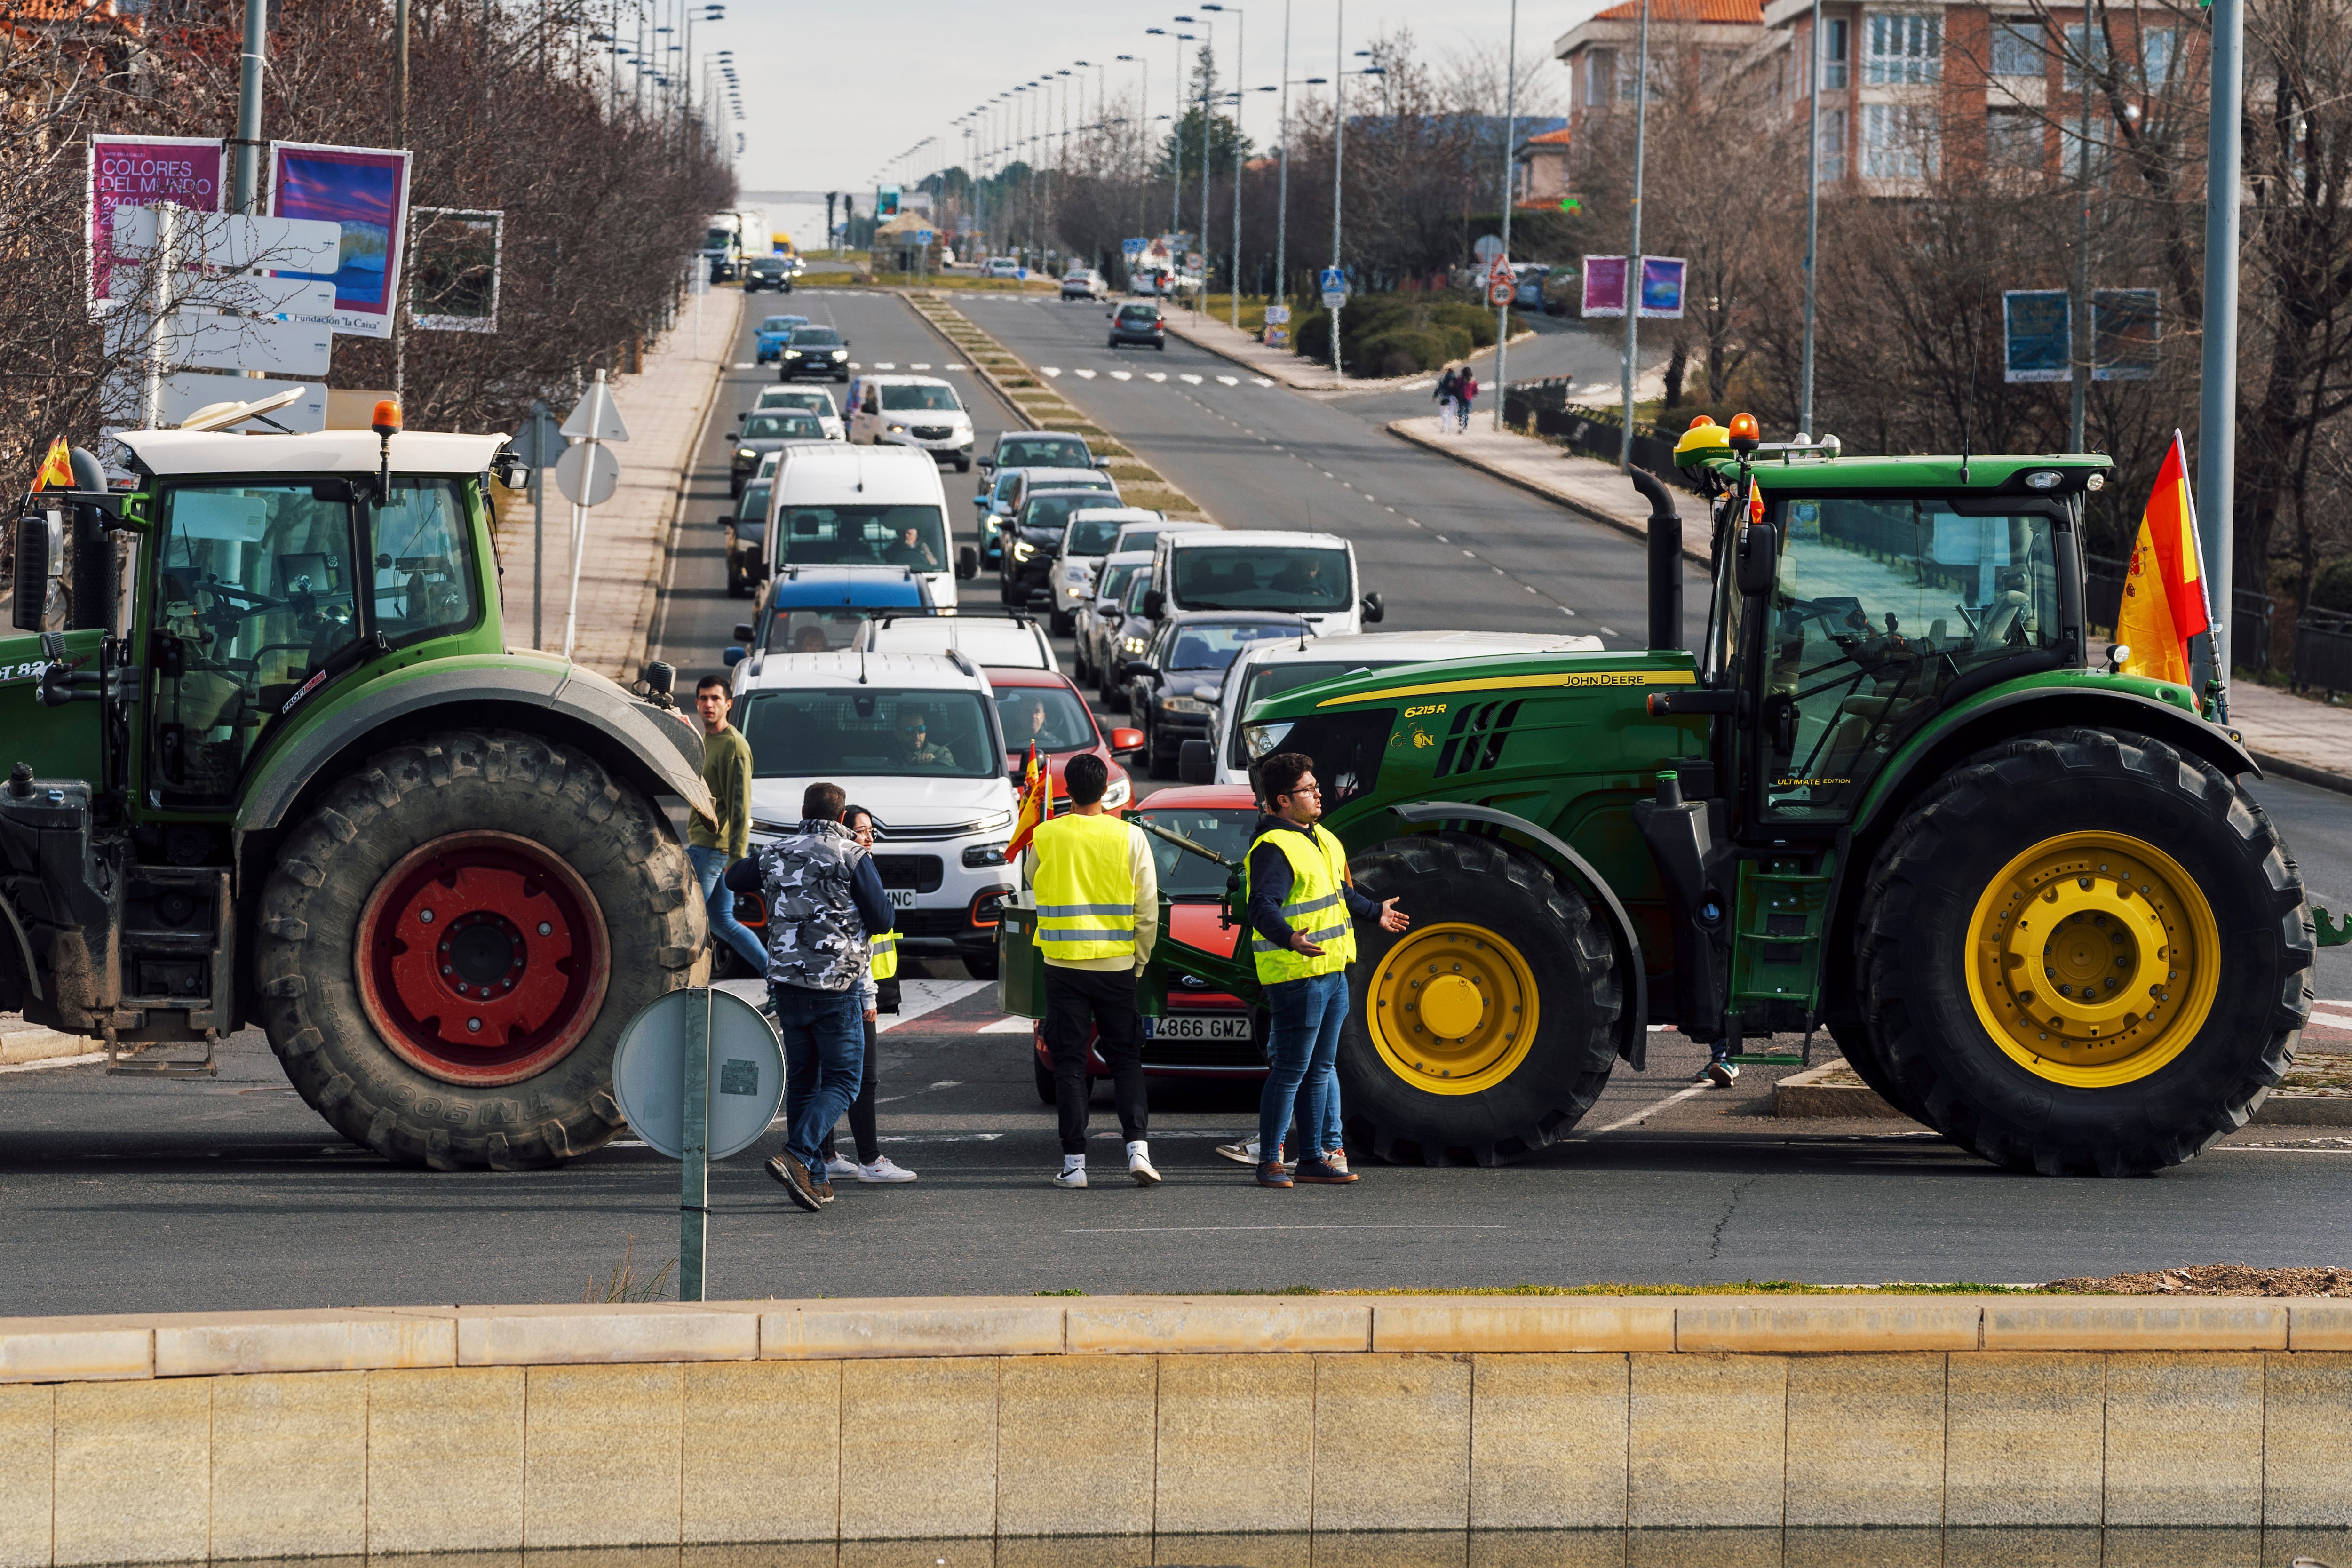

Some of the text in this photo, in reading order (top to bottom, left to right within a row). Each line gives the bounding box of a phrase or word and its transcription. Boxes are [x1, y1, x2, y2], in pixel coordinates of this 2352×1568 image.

[102, 159, 192, 177] COLORES
[101, 176, 211, 194] DEL MUNDO
[17, 660, 56, 677] 82
[1563, 675, 1644, 685] JOHN DEERE
[311, 818, 402, 951] TRELLEBORG
[887, 891, 911, 906] NC
[1156, 1019, 1203, 1036] 4866
[1210, 1019, 1247, 1037] GMZ
[319, 973, 551, 1125] TM900 HIGH POWER
